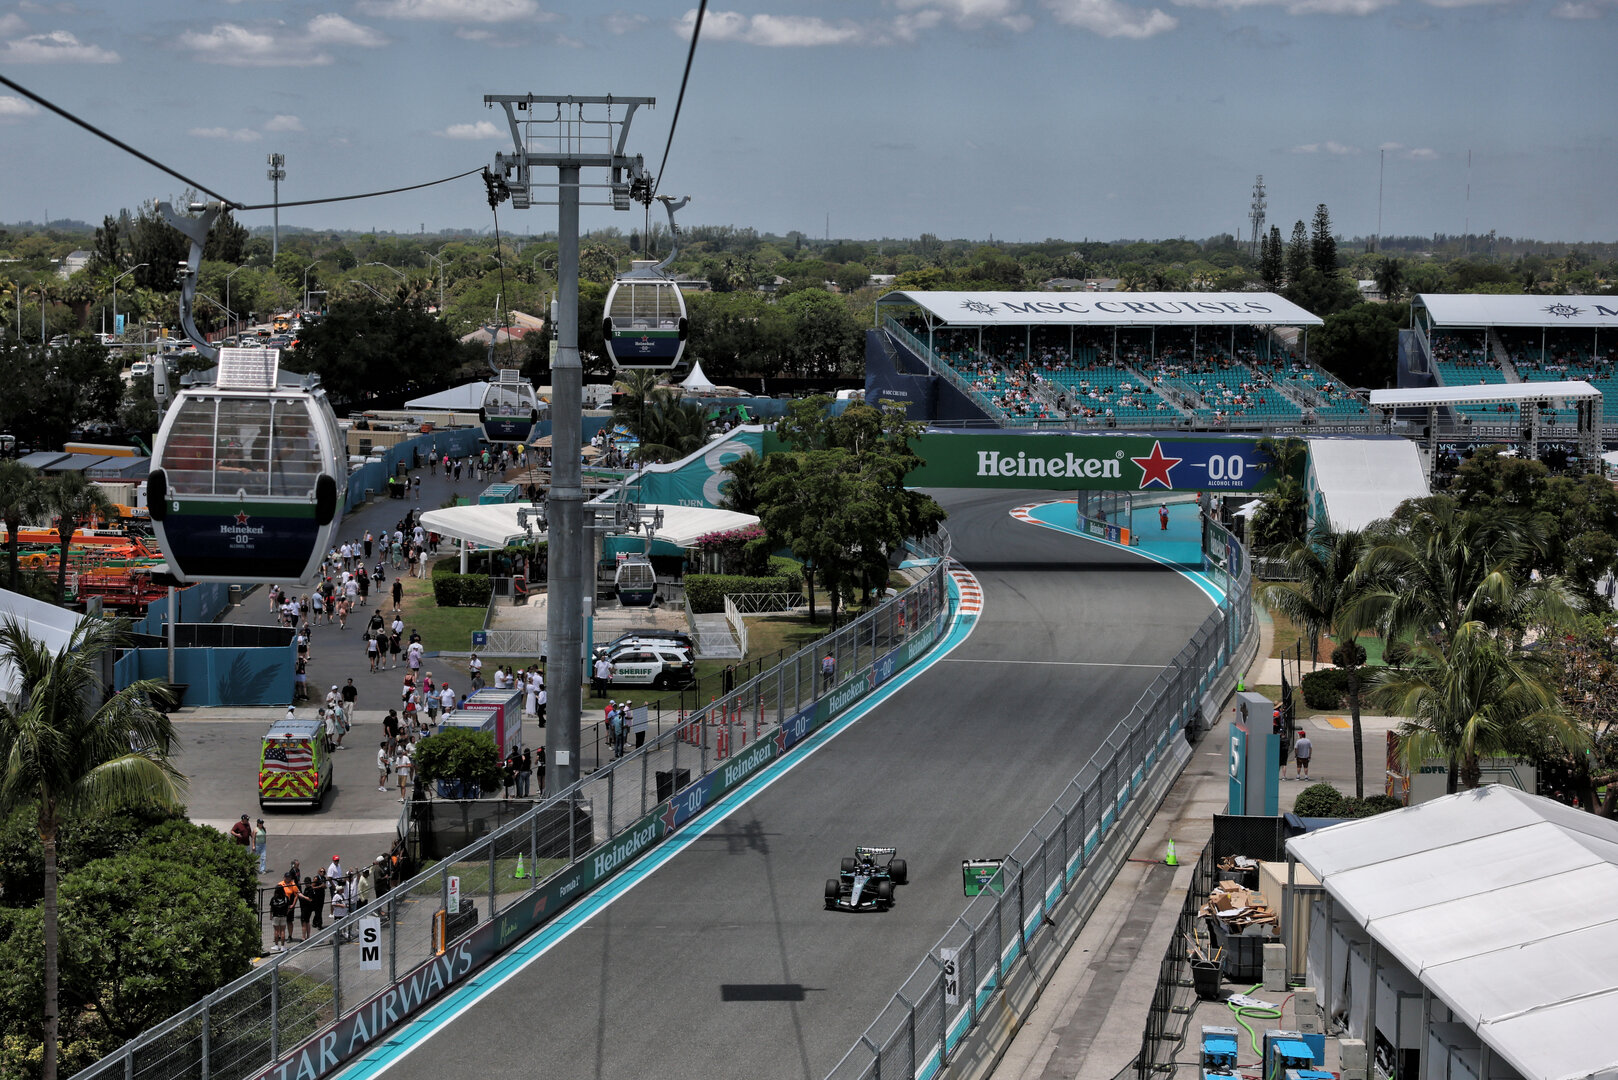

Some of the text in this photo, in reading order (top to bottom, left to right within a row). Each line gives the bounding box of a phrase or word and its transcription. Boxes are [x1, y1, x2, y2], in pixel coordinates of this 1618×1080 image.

[1001, 301, 1273, 314] MSC CRUISES
[1438, 443, 1457, 451] MSC
[703, 440, 753, 507] 8
[1208, 454, 1244, 480] 0.0
[172, 501, 180, 512] 9
[678, 499, 704, 507] TURN
[908, 631, 932, 660] Heineken
[829, 679, 864, 714] Heineken
[724, 743, 772, 788] Heineken
[1231, 736, 1240, 777] 5
[593, 823, 656, 880] Heineken
[363, 927, 377, 943] S
[362, 946, 379, 962] M
[347, 939, 473, 1054] AIRWAYS
